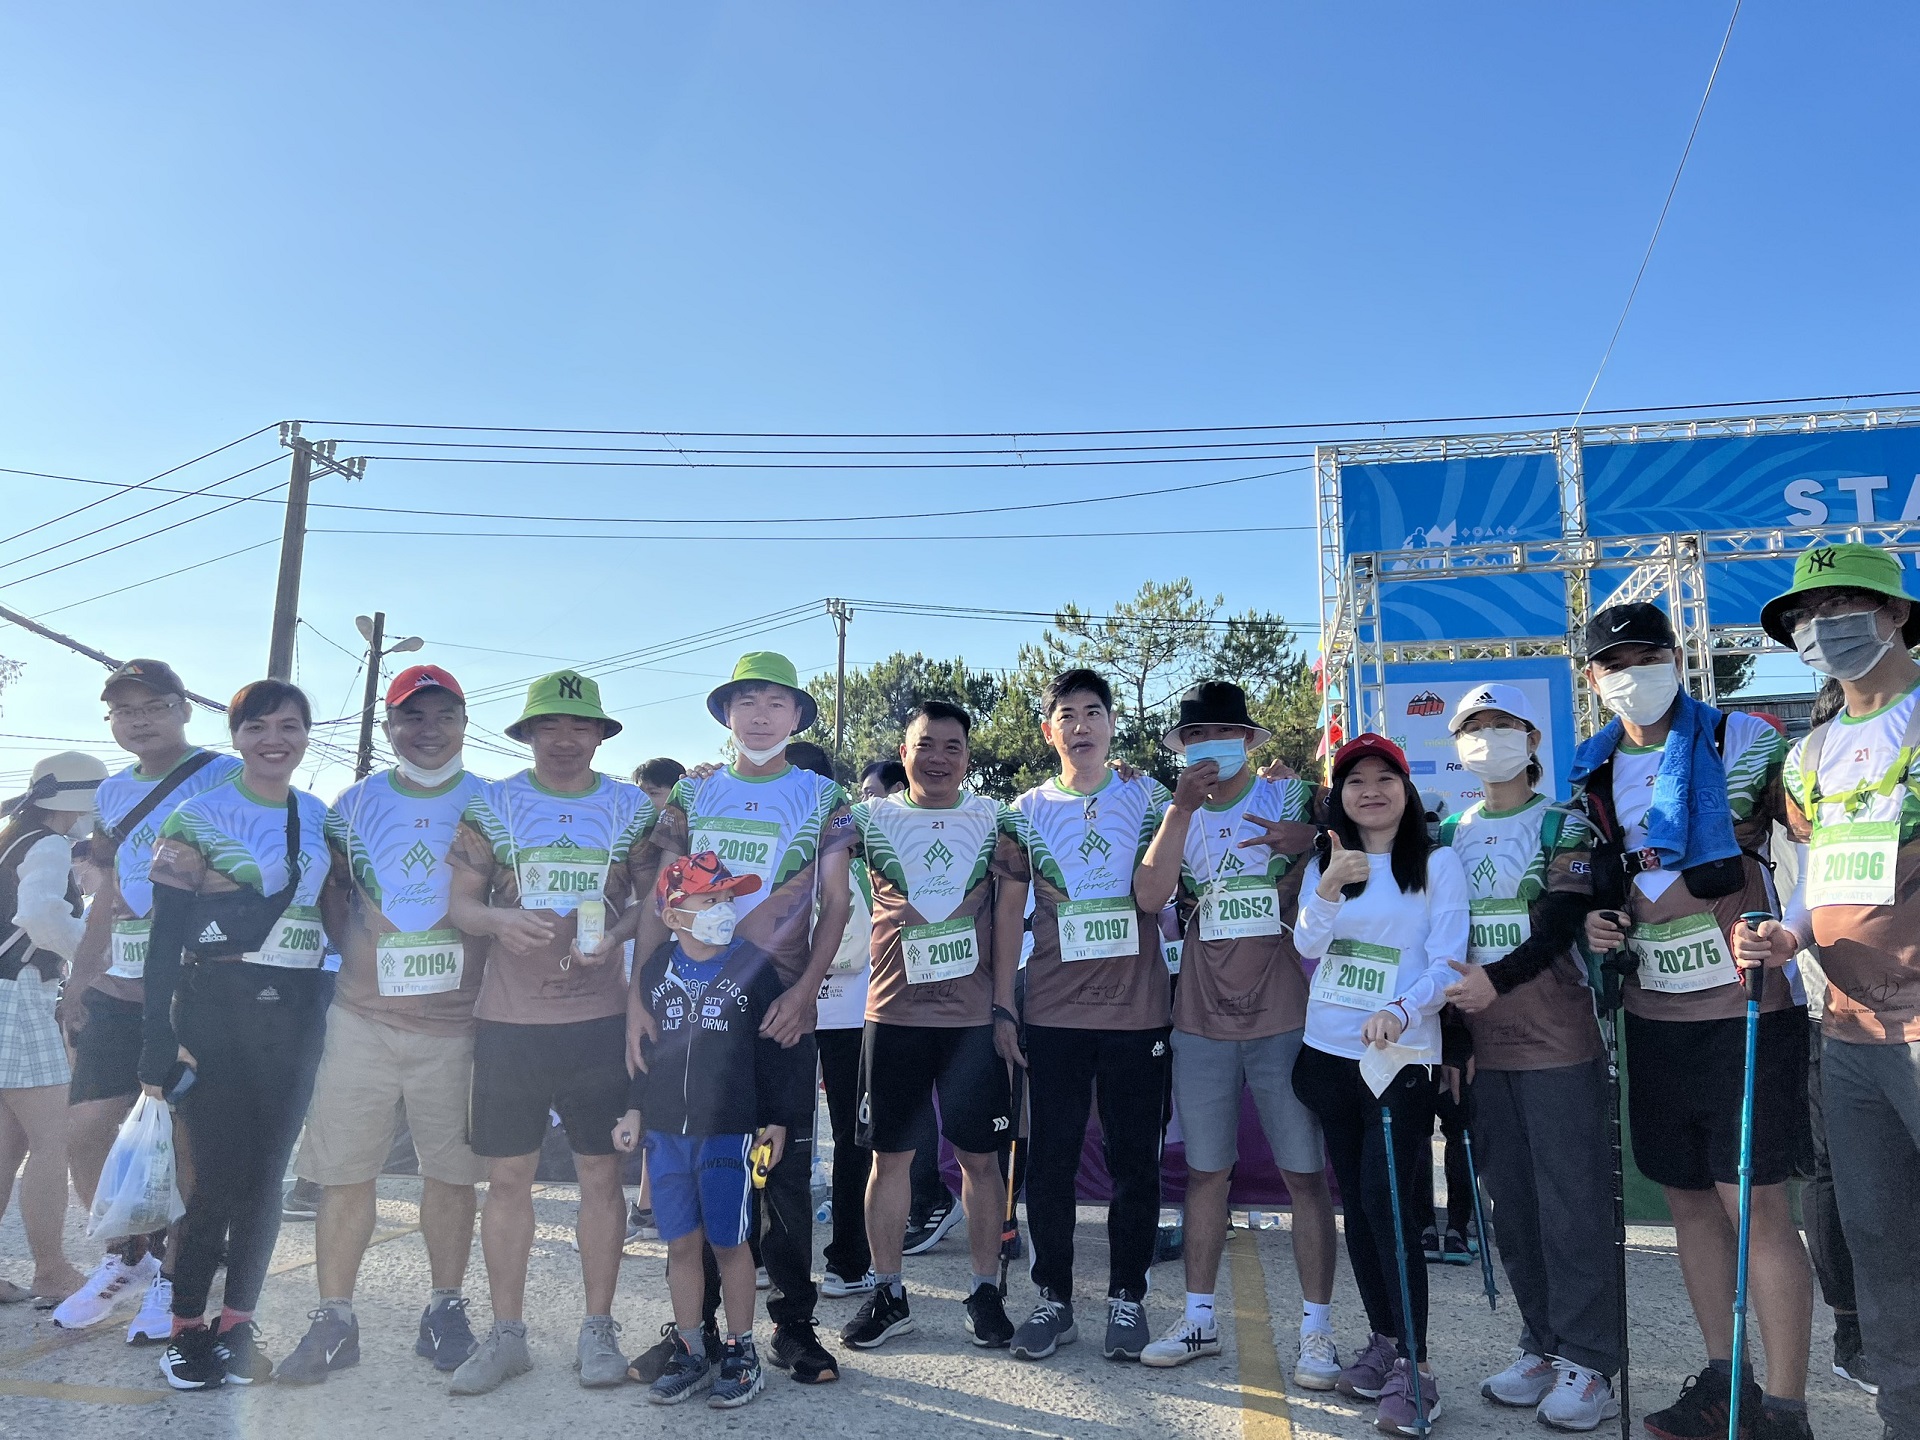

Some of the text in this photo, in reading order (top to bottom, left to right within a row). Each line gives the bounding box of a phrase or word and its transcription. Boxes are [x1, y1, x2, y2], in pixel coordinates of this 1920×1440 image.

[1855, 748, 1870, 762] 21
[1446, 763, 1464, 771] Re
[745, 802, 758, 811] 21
[414, 818, 430, 829] 21
[559, 814, 573, 823] 21
[931, 821, 945, 829] 21
[1219, 828, 1232, 838] 21
[1485, 836, 1498, 844] 21
[717, 839, 769, 864] 20192
[1084, 865, 1113, 881] The
[1824, 852, 1885, 881] 20196
[402, 881, 433, 896] The
[548, 870, 599, 892] 20195
[925, 875, 952, 887] The
[1074, 877, 1125, 897] forest
[913, 886, 960, 900] forest
[387, 892, 444, 911] forest
[1218, 896, 1274, 921] 20952
[1084, 918, 1129, 942] 20197
[1470, 923, 1521, 948] 20190
[199, 934, 228, 943] adidas
[279, 926, 320, 951] 20193
[928, 937, 973, 965] 20102
[1654, 939, 1721, 974] 20275
[404, 952, 457, 977] 20194
[1337, 964, 1386, 994] 20191
[665, 997, 725, 1006] VAR SITY
[671, 1007, 716, 1016] 18 49
[662, 1017, 728, 1031] CALIF ORNIA
